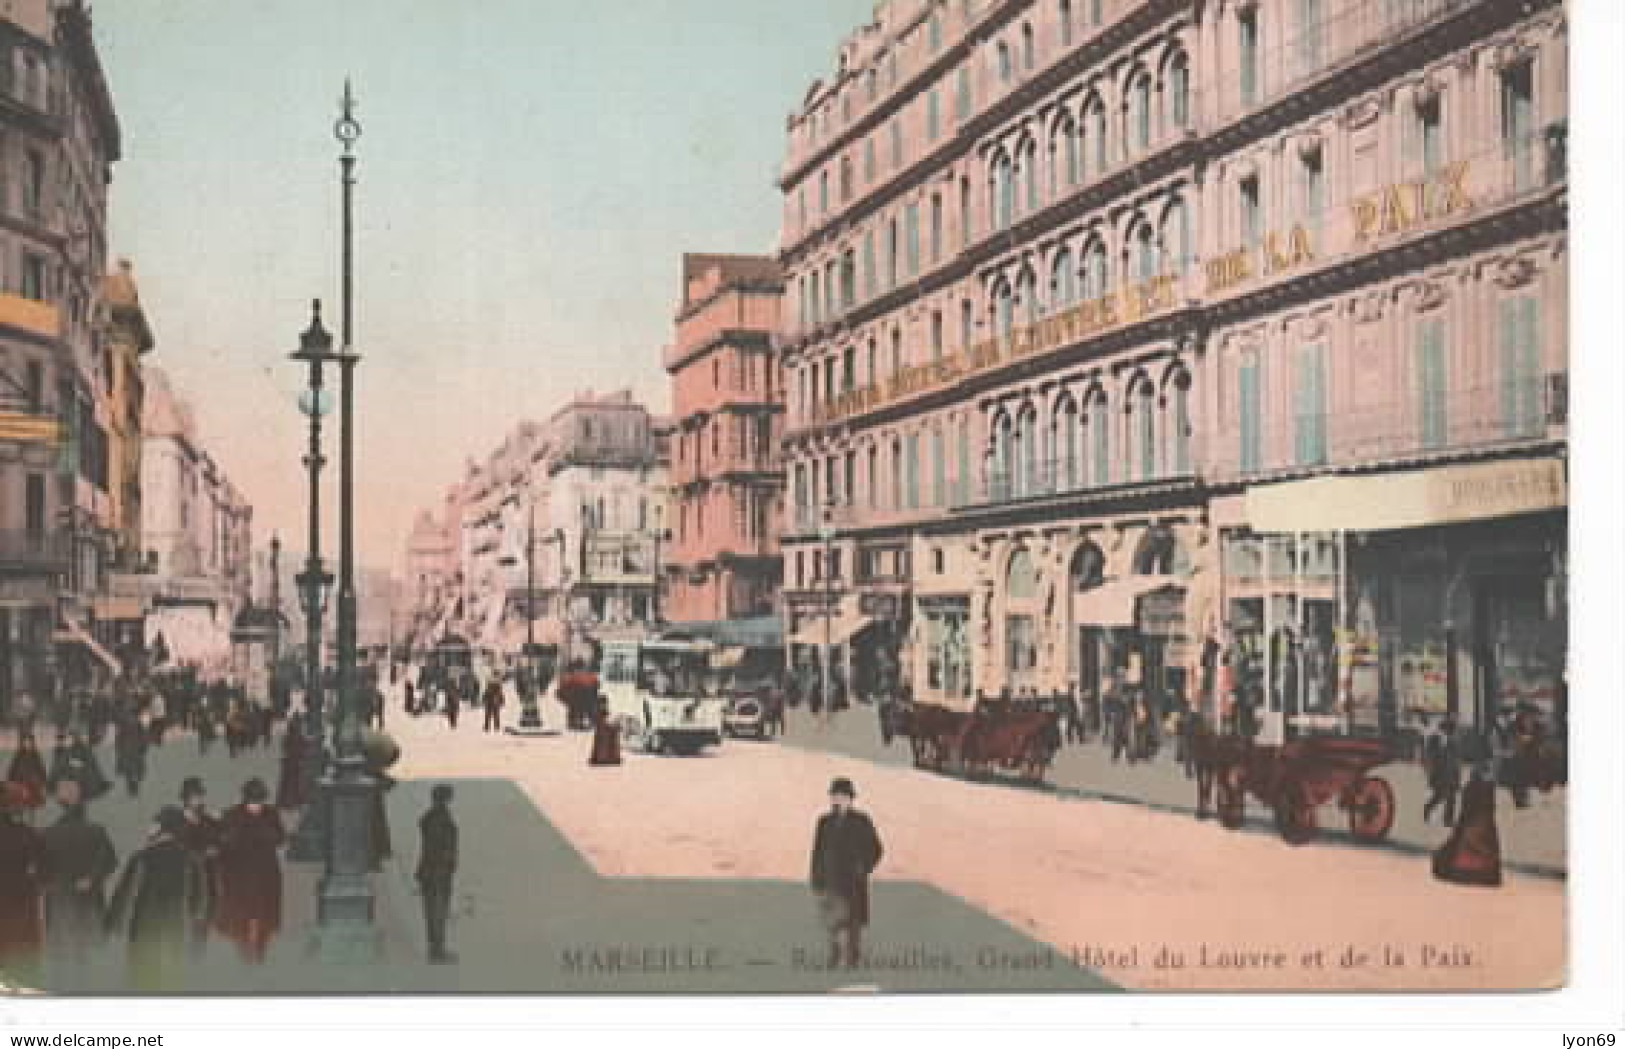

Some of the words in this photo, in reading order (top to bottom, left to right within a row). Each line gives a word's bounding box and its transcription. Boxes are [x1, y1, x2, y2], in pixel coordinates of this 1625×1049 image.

[1262, 222, 1314, 276] LA
[1350, 160, 1474, 244] PAIX
[1154, 943, 1186, 969] du
[1200, 942, 1288, 969] Louvre
[1301, 948, 1325, 969] et
[1338, 944, 1371, 969] de
[1382, 944, 1406, 968] la
